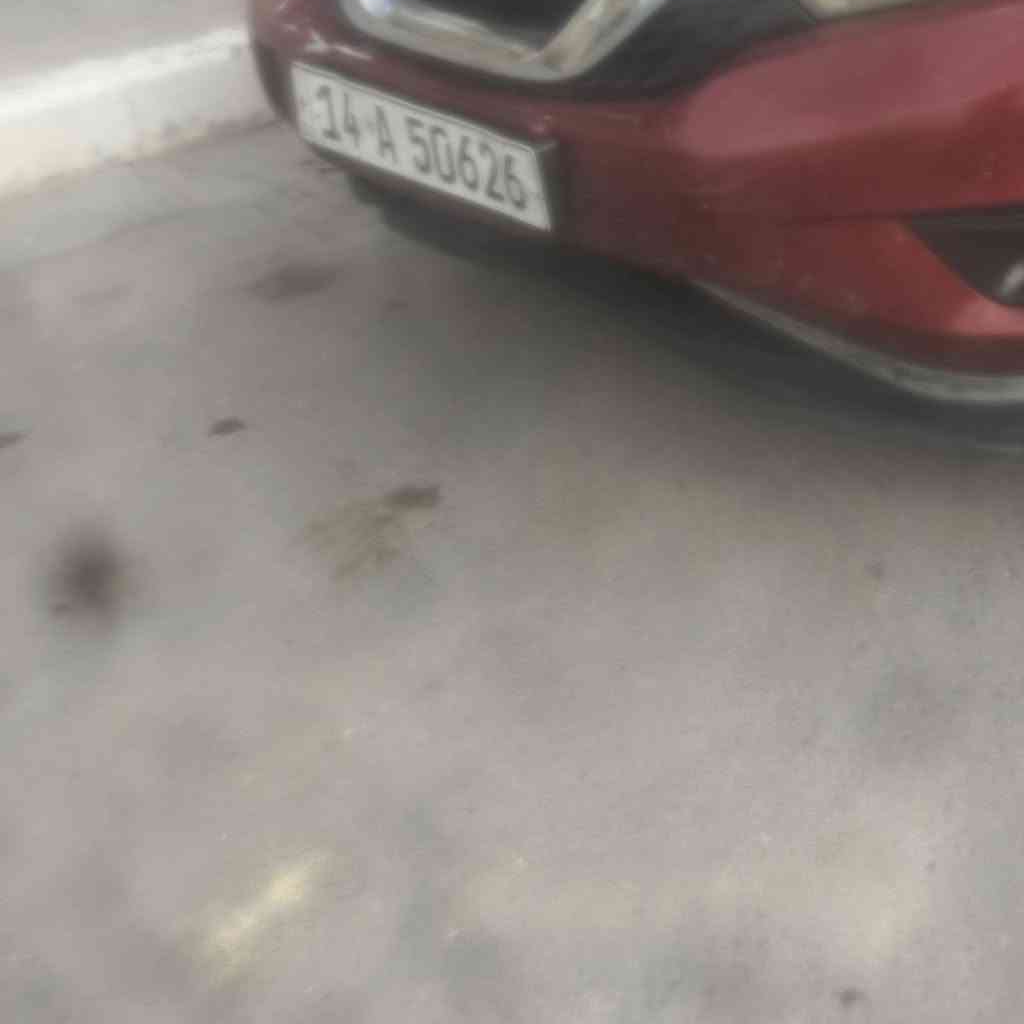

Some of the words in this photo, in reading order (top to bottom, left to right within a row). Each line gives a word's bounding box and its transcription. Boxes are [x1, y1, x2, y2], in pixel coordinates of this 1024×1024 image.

[315, 84, 361, 148] 14
[374, 104, 399, 166] A
[404, 115, 527, 211] 50626
